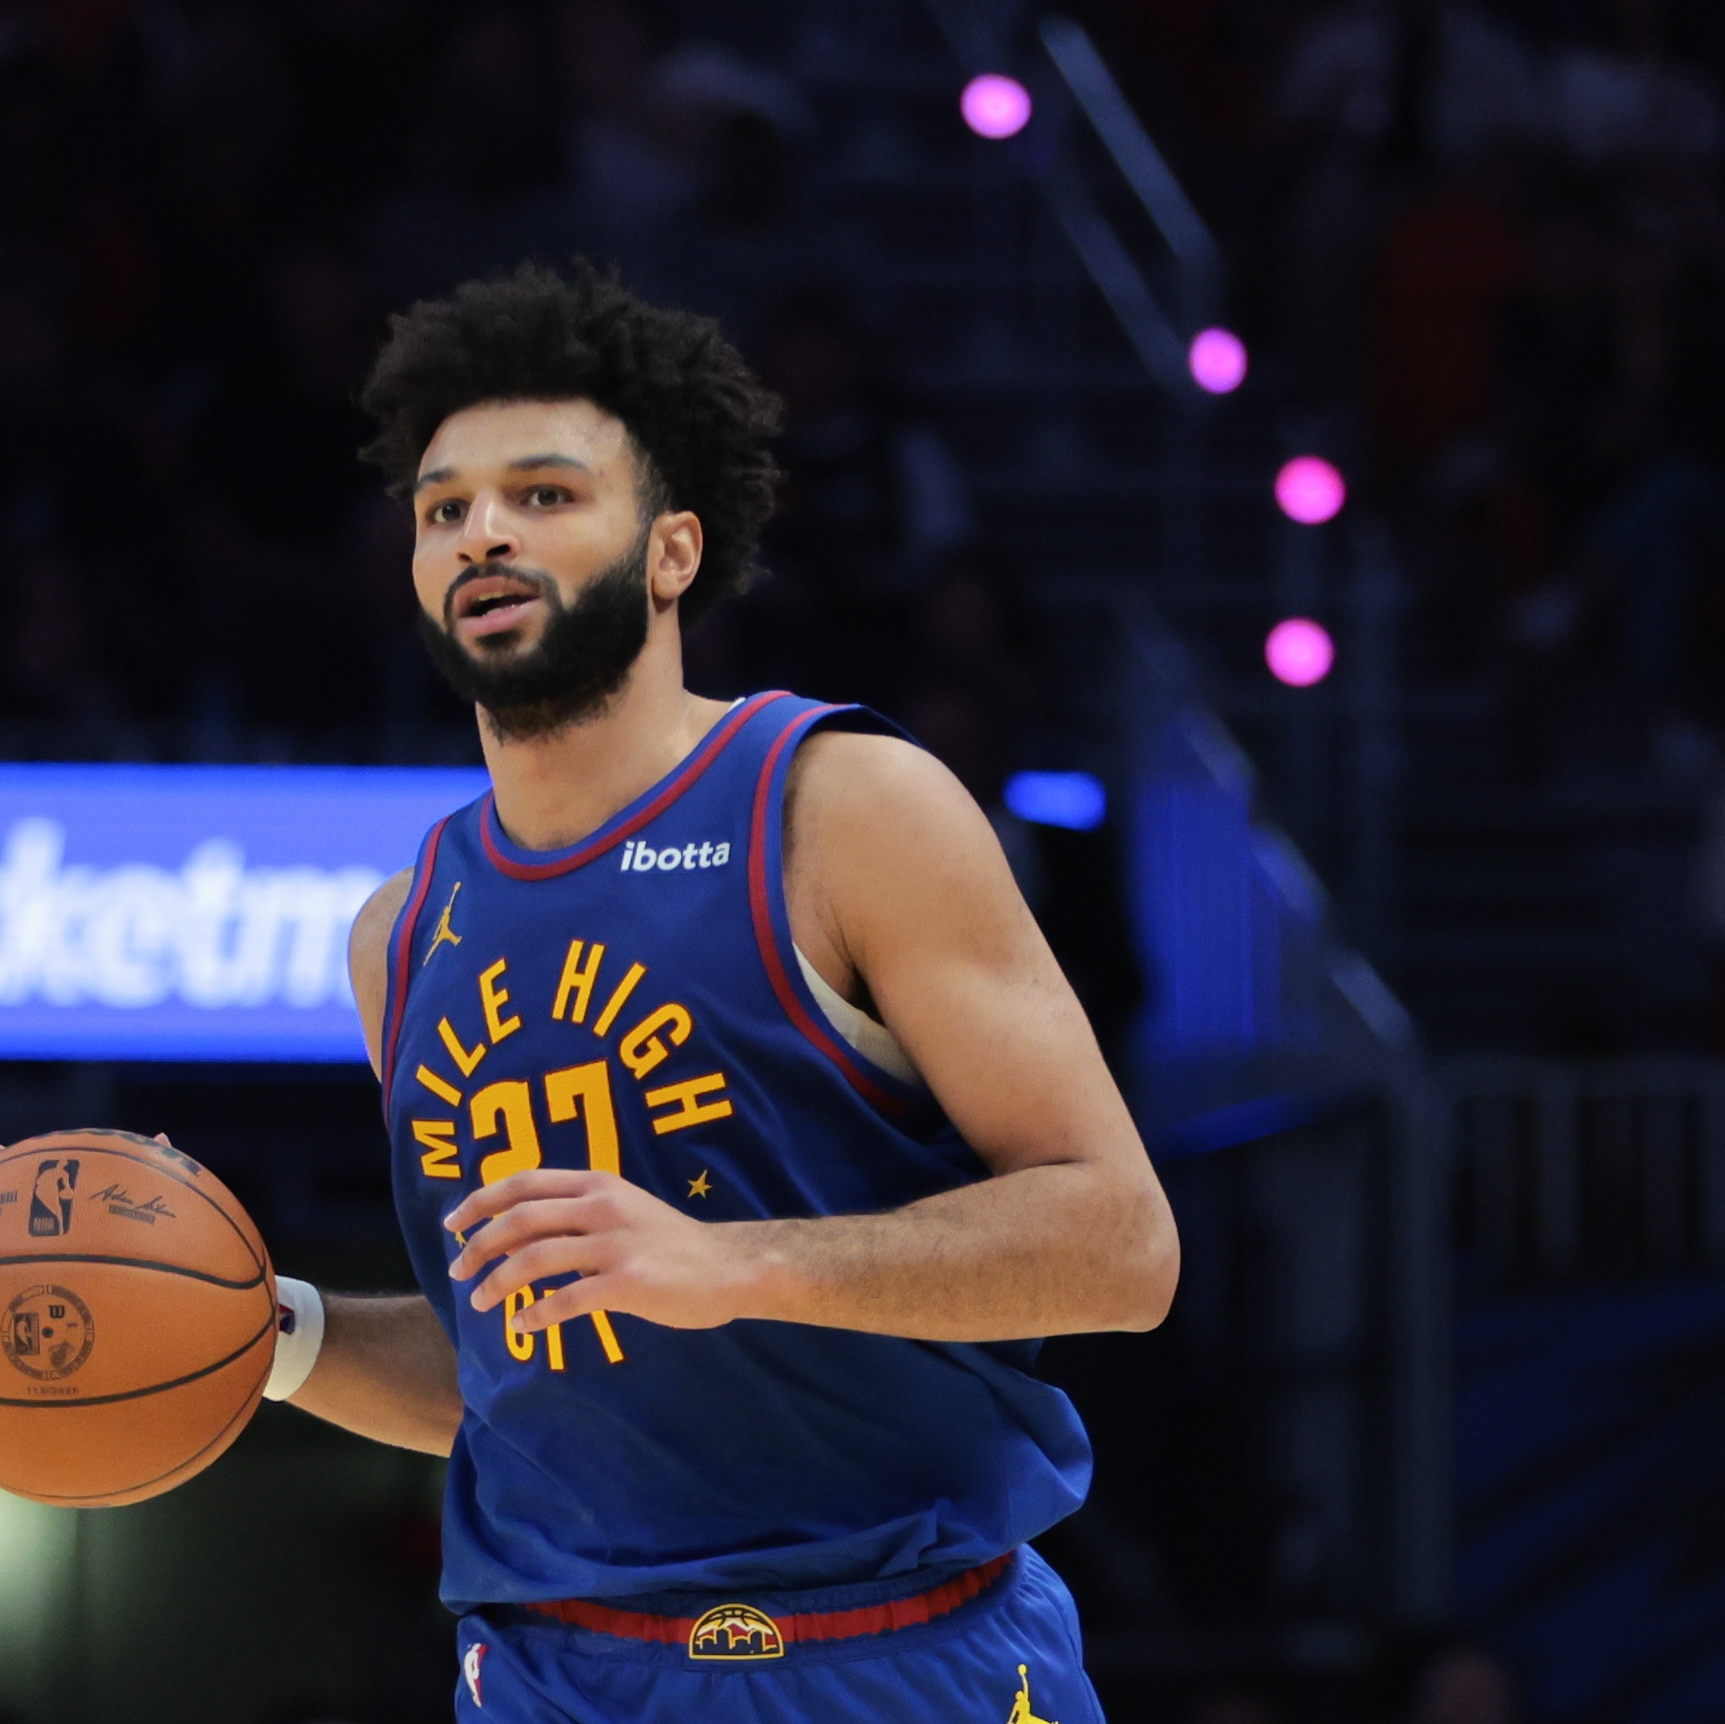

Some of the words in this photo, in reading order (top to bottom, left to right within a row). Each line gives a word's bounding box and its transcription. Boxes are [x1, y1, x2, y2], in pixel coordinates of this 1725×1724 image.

[620, 840, 731, 872] ibotta
[411, 957, 523, 1179] MILE
[551, 939, 733, 1136] HIGH
